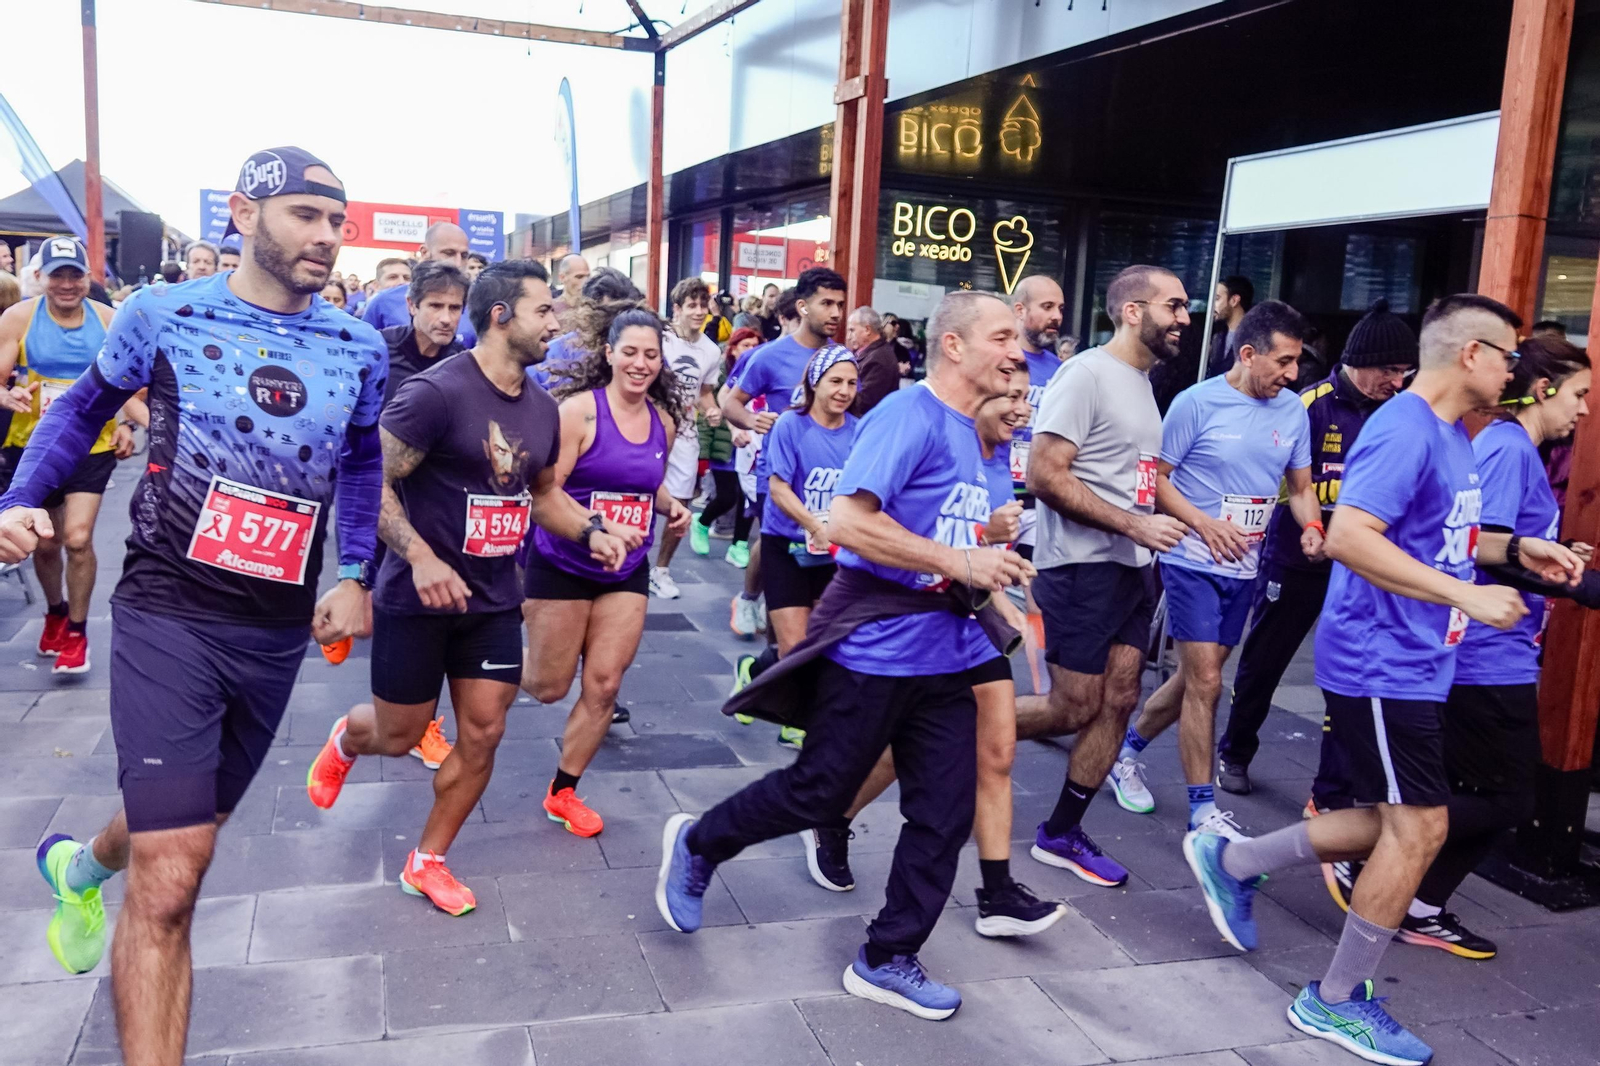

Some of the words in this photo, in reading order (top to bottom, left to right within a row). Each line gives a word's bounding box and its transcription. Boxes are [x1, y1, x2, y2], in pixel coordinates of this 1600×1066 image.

[378, 218, 424, 228] CONCELLO
[398, 228, 418, 236] VIGO
[893, 201, 977, 243] BICO
[892, 237, 915, 257] de
[919, 243, 972, 262] xeado
[804, 466, 843, 492] COR
[490, 512, 522, 536] 594
[611, 505, 643, 525] 798
[1244, 509, 1264, 526] 112
[238, 511, 299, 551] 577
[215, 548, 285, 577] Alcampo
